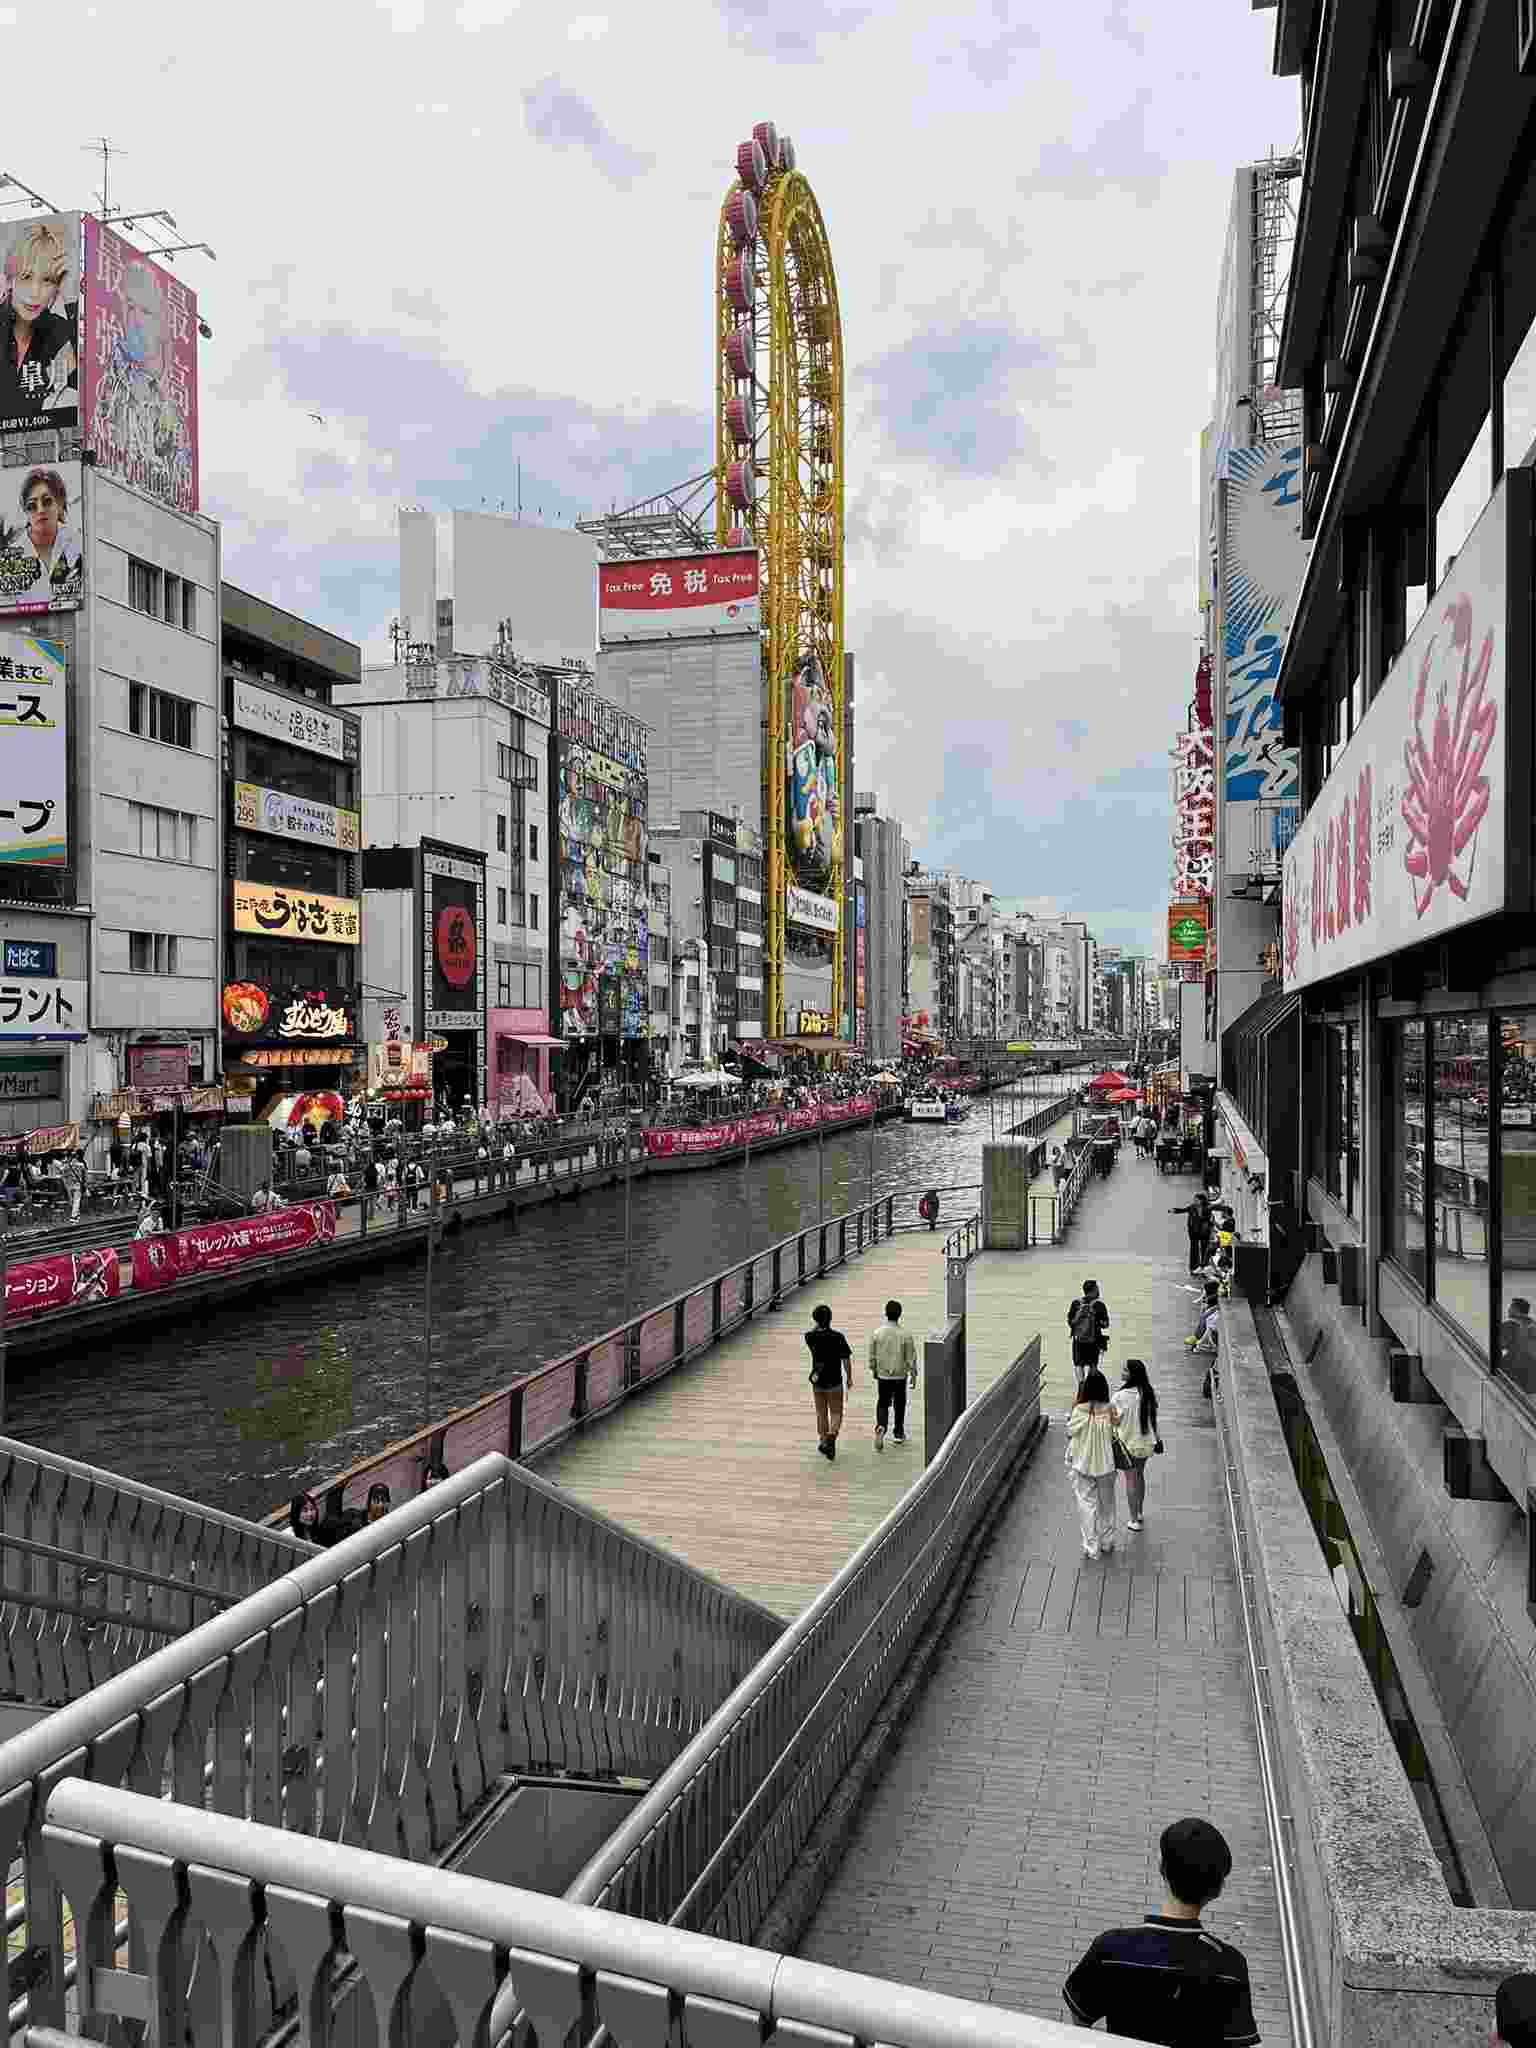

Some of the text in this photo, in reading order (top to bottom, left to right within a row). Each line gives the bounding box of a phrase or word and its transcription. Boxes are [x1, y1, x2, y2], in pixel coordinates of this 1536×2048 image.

[649, 569, 707, 597] 免税
[7, 947, 41, 968] たばこ
[0, 986, 73, 1024] ラント
